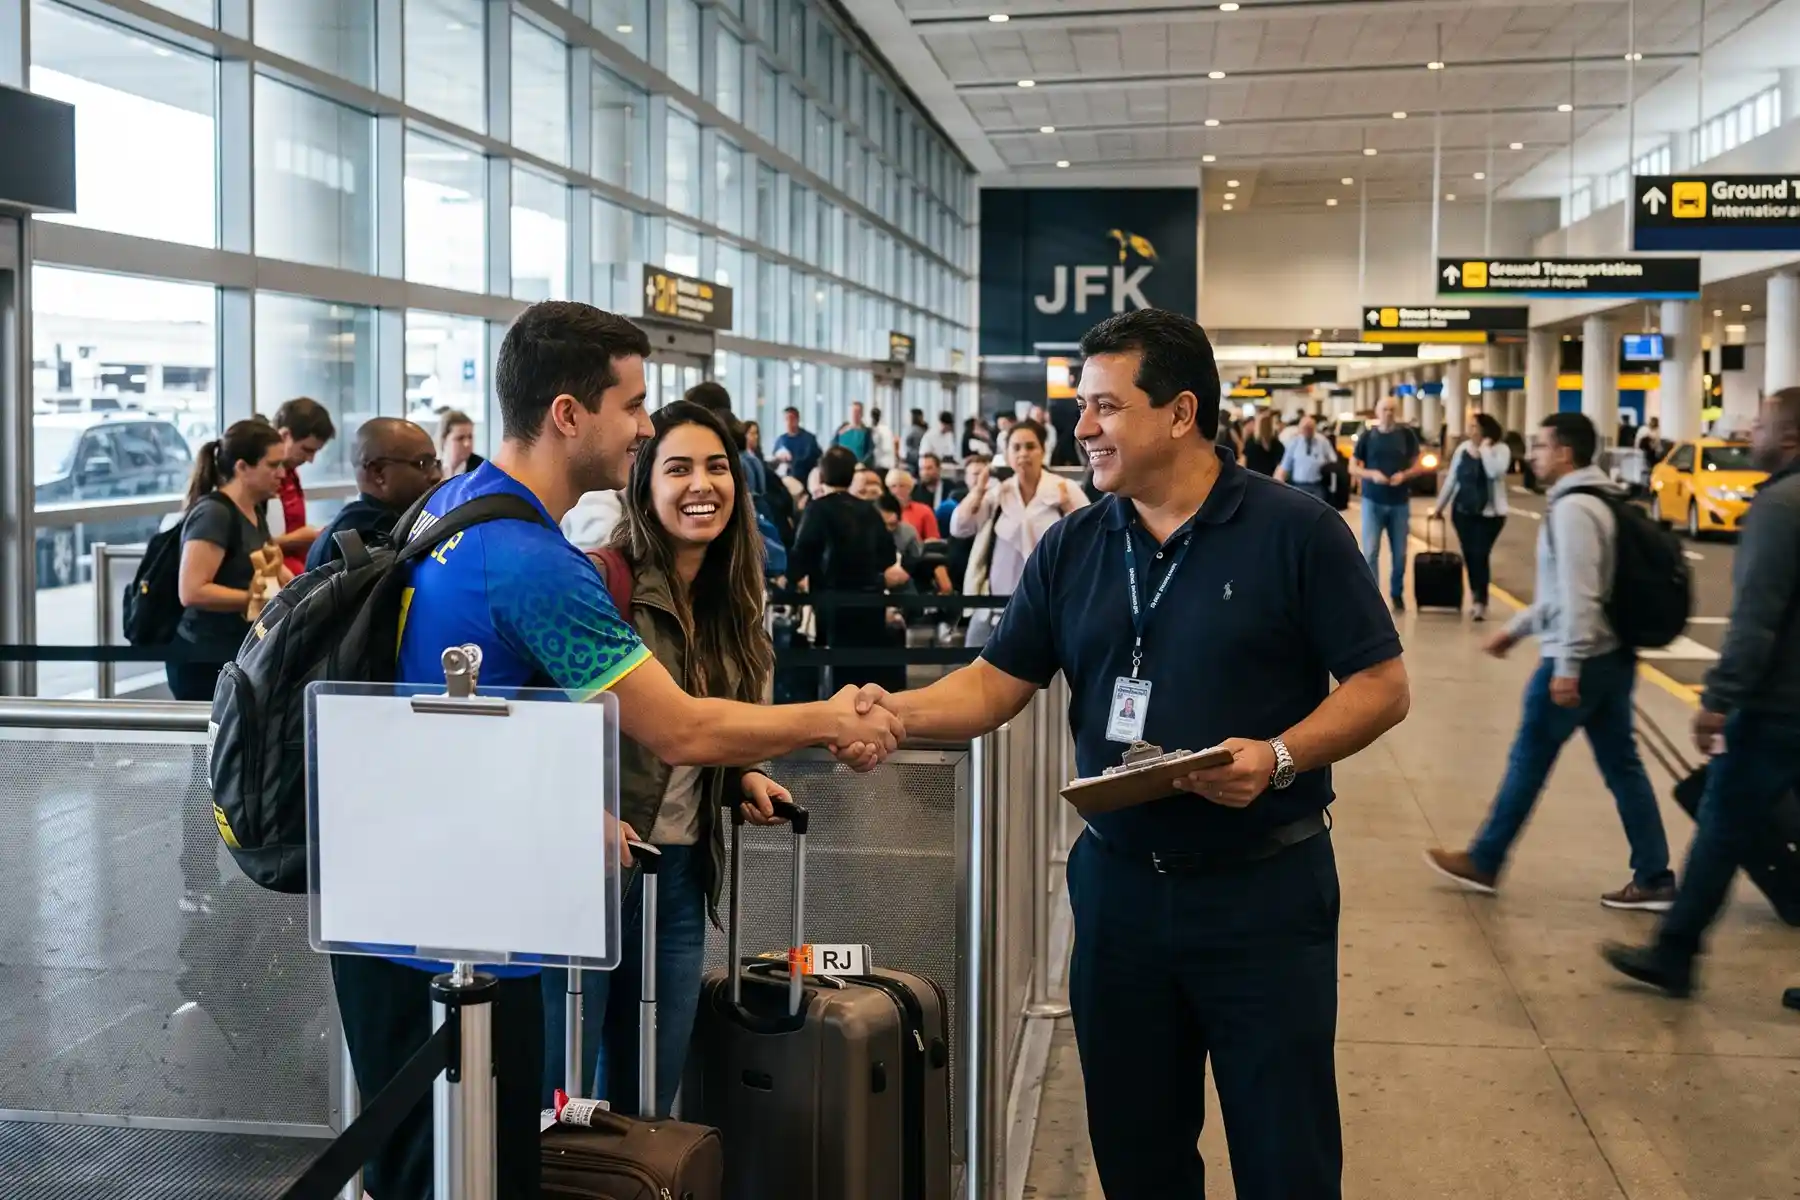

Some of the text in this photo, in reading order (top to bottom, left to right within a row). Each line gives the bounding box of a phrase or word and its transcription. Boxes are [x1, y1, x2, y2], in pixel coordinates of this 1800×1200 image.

[1711, 179, 1788, 200] Ground
[1489, 261, 1643, 278] Ground Transportation
[1034, 265, 1153, 314] JFK
[822, 950, 852, 970] RJ
